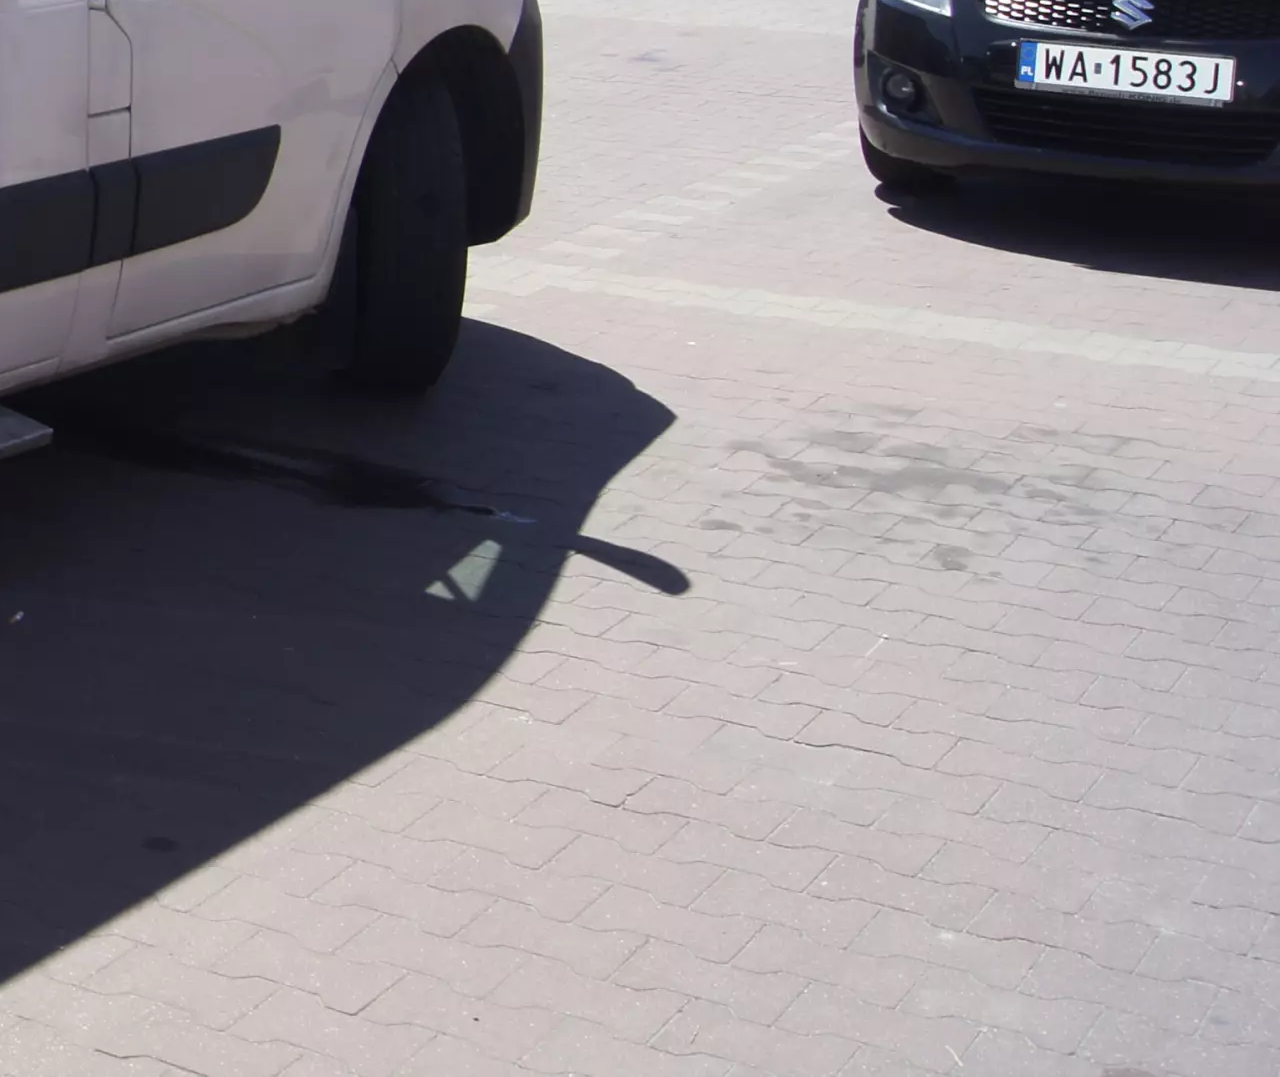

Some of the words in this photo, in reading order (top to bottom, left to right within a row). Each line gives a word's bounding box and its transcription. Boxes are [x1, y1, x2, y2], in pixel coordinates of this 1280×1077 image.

[1021, 65, 1033, 76] PL
[1045, 48, 1088, 83] WA
[1109, 54, 1220, 95] 1583J
